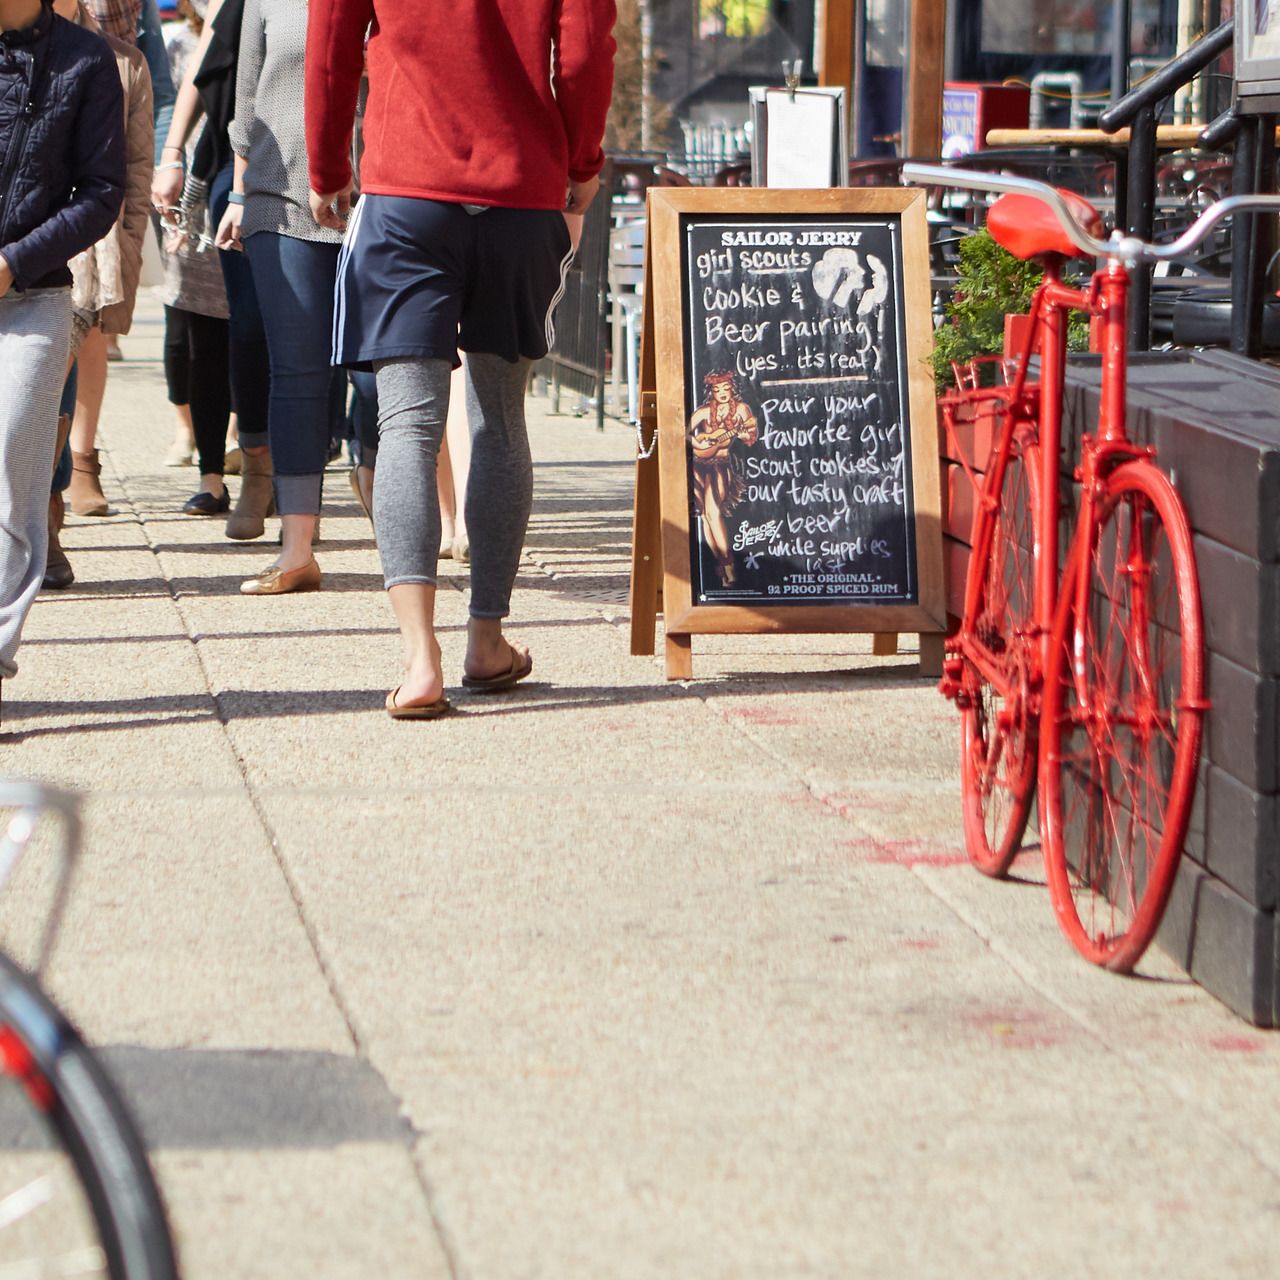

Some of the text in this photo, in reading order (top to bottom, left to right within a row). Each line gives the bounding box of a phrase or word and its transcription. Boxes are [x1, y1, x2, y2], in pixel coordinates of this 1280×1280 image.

[721, 231, 863, 247] SAILOR JERRY
[696, 248, 812, 278] girl scouts
[790, 281, 806, 310] &
[705, 315, 771, 345] Beer
[760, 393, 877, 422] pair your
[759, 418, 851, 450] favorite
[747, 450, 802, 478] scout
[810, 451, 880, 477] cookies
[748, 476, 906, 516] our tasty craft
[767, 537, 892, 561] while supplies
[789, 573, 875, 583] THE ORIGINAL
[806, 556, 846, 573] last
[767, 585, 781, 595] 92
[783, 585, 824, 595] PROOF
[827, 585, 869, 594] SPICED
[871, 584, 898, 594] RUM
